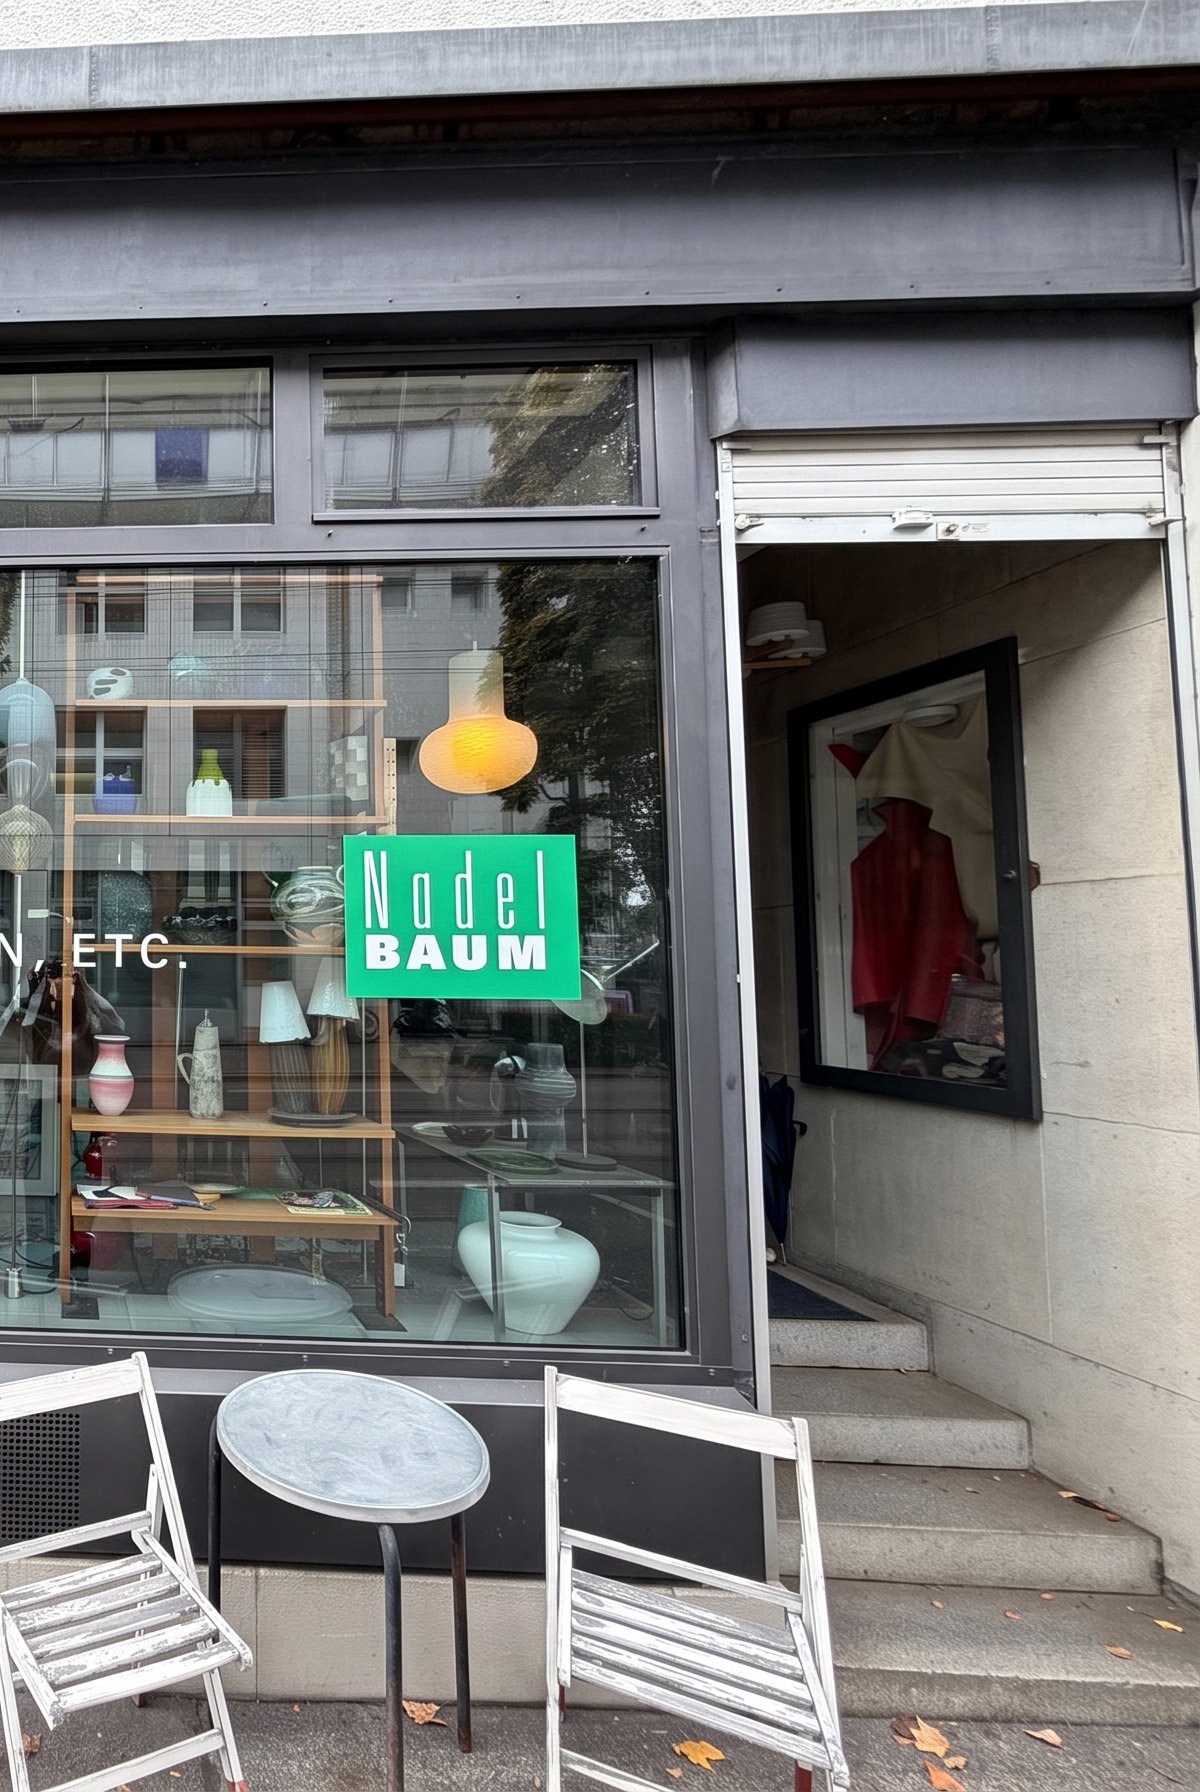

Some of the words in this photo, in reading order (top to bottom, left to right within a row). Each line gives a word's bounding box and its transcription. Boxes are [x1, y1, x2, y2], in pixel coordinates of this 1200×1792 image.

[363, 850, 546, 930] Nadel
[72, 933, 188, 969] ETC.
[365, 934, 547, 971] BAUM
